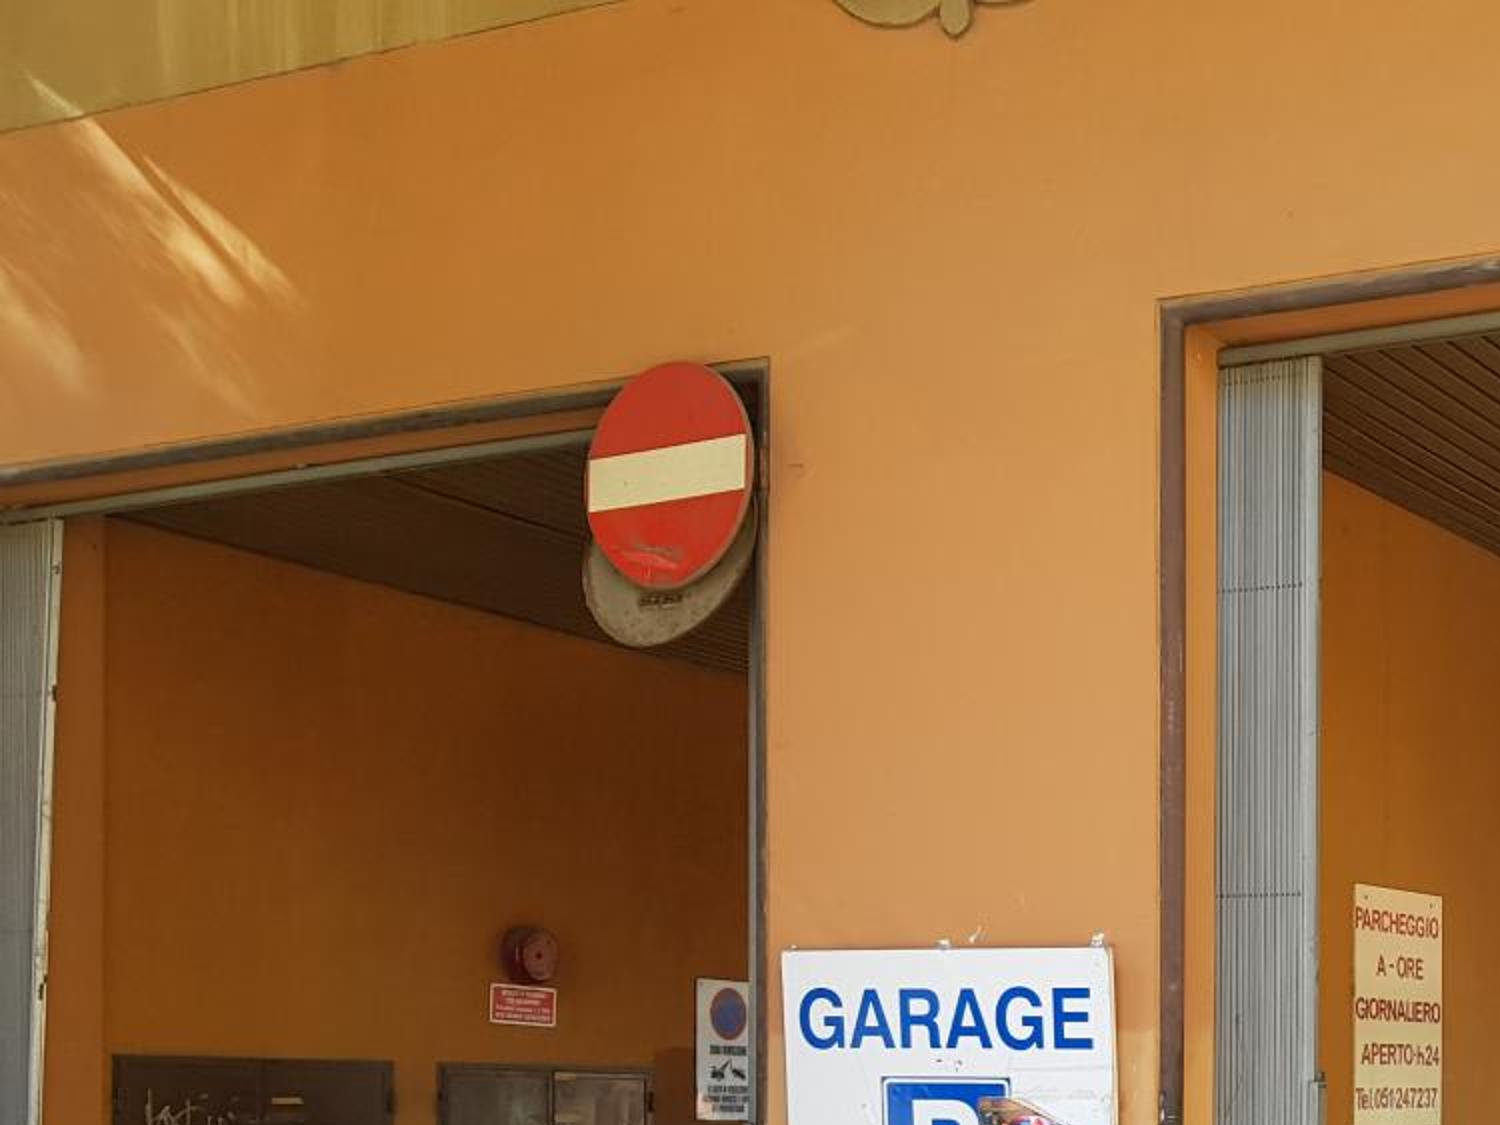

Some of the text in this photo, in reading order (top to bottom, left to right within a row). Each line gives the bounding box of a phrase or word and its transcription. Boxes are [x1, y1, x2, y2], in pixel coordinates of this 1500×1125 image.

[1355, 906, 1439, 939] PARCHEGGIO
[799, 986, 1094, 1050] GARAGE
[1355, 996, 1441, 1023] GIORNALIERO
